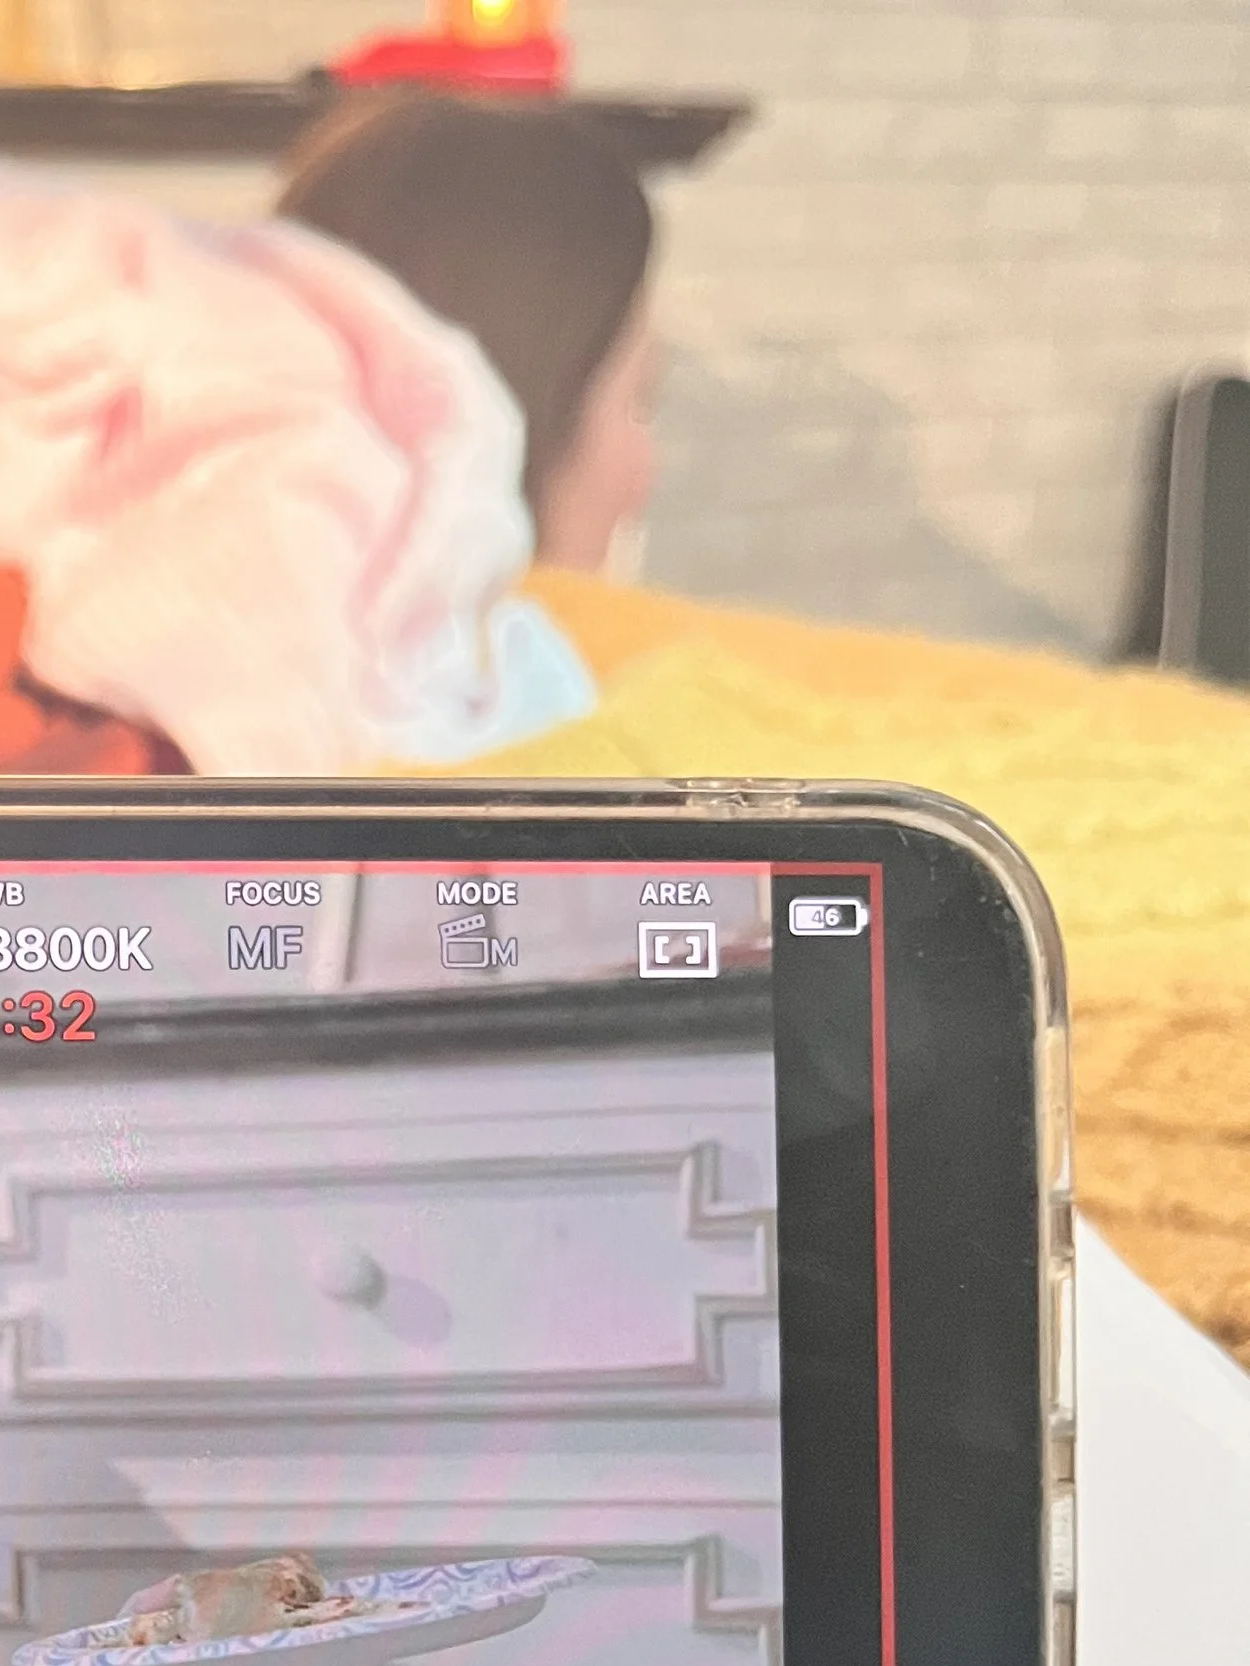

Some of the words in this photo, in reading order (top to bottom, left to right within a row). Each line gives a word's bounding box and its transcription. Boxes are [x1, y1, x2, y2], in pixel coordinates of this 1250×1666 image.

[225, 880, 322, 906] FOCUS
[437, 881, 519, 905] MODE
[640, 881, 712, 905] AREA
[811, 908, 841, 927] 46
[227, 925, 304, 971] MF
